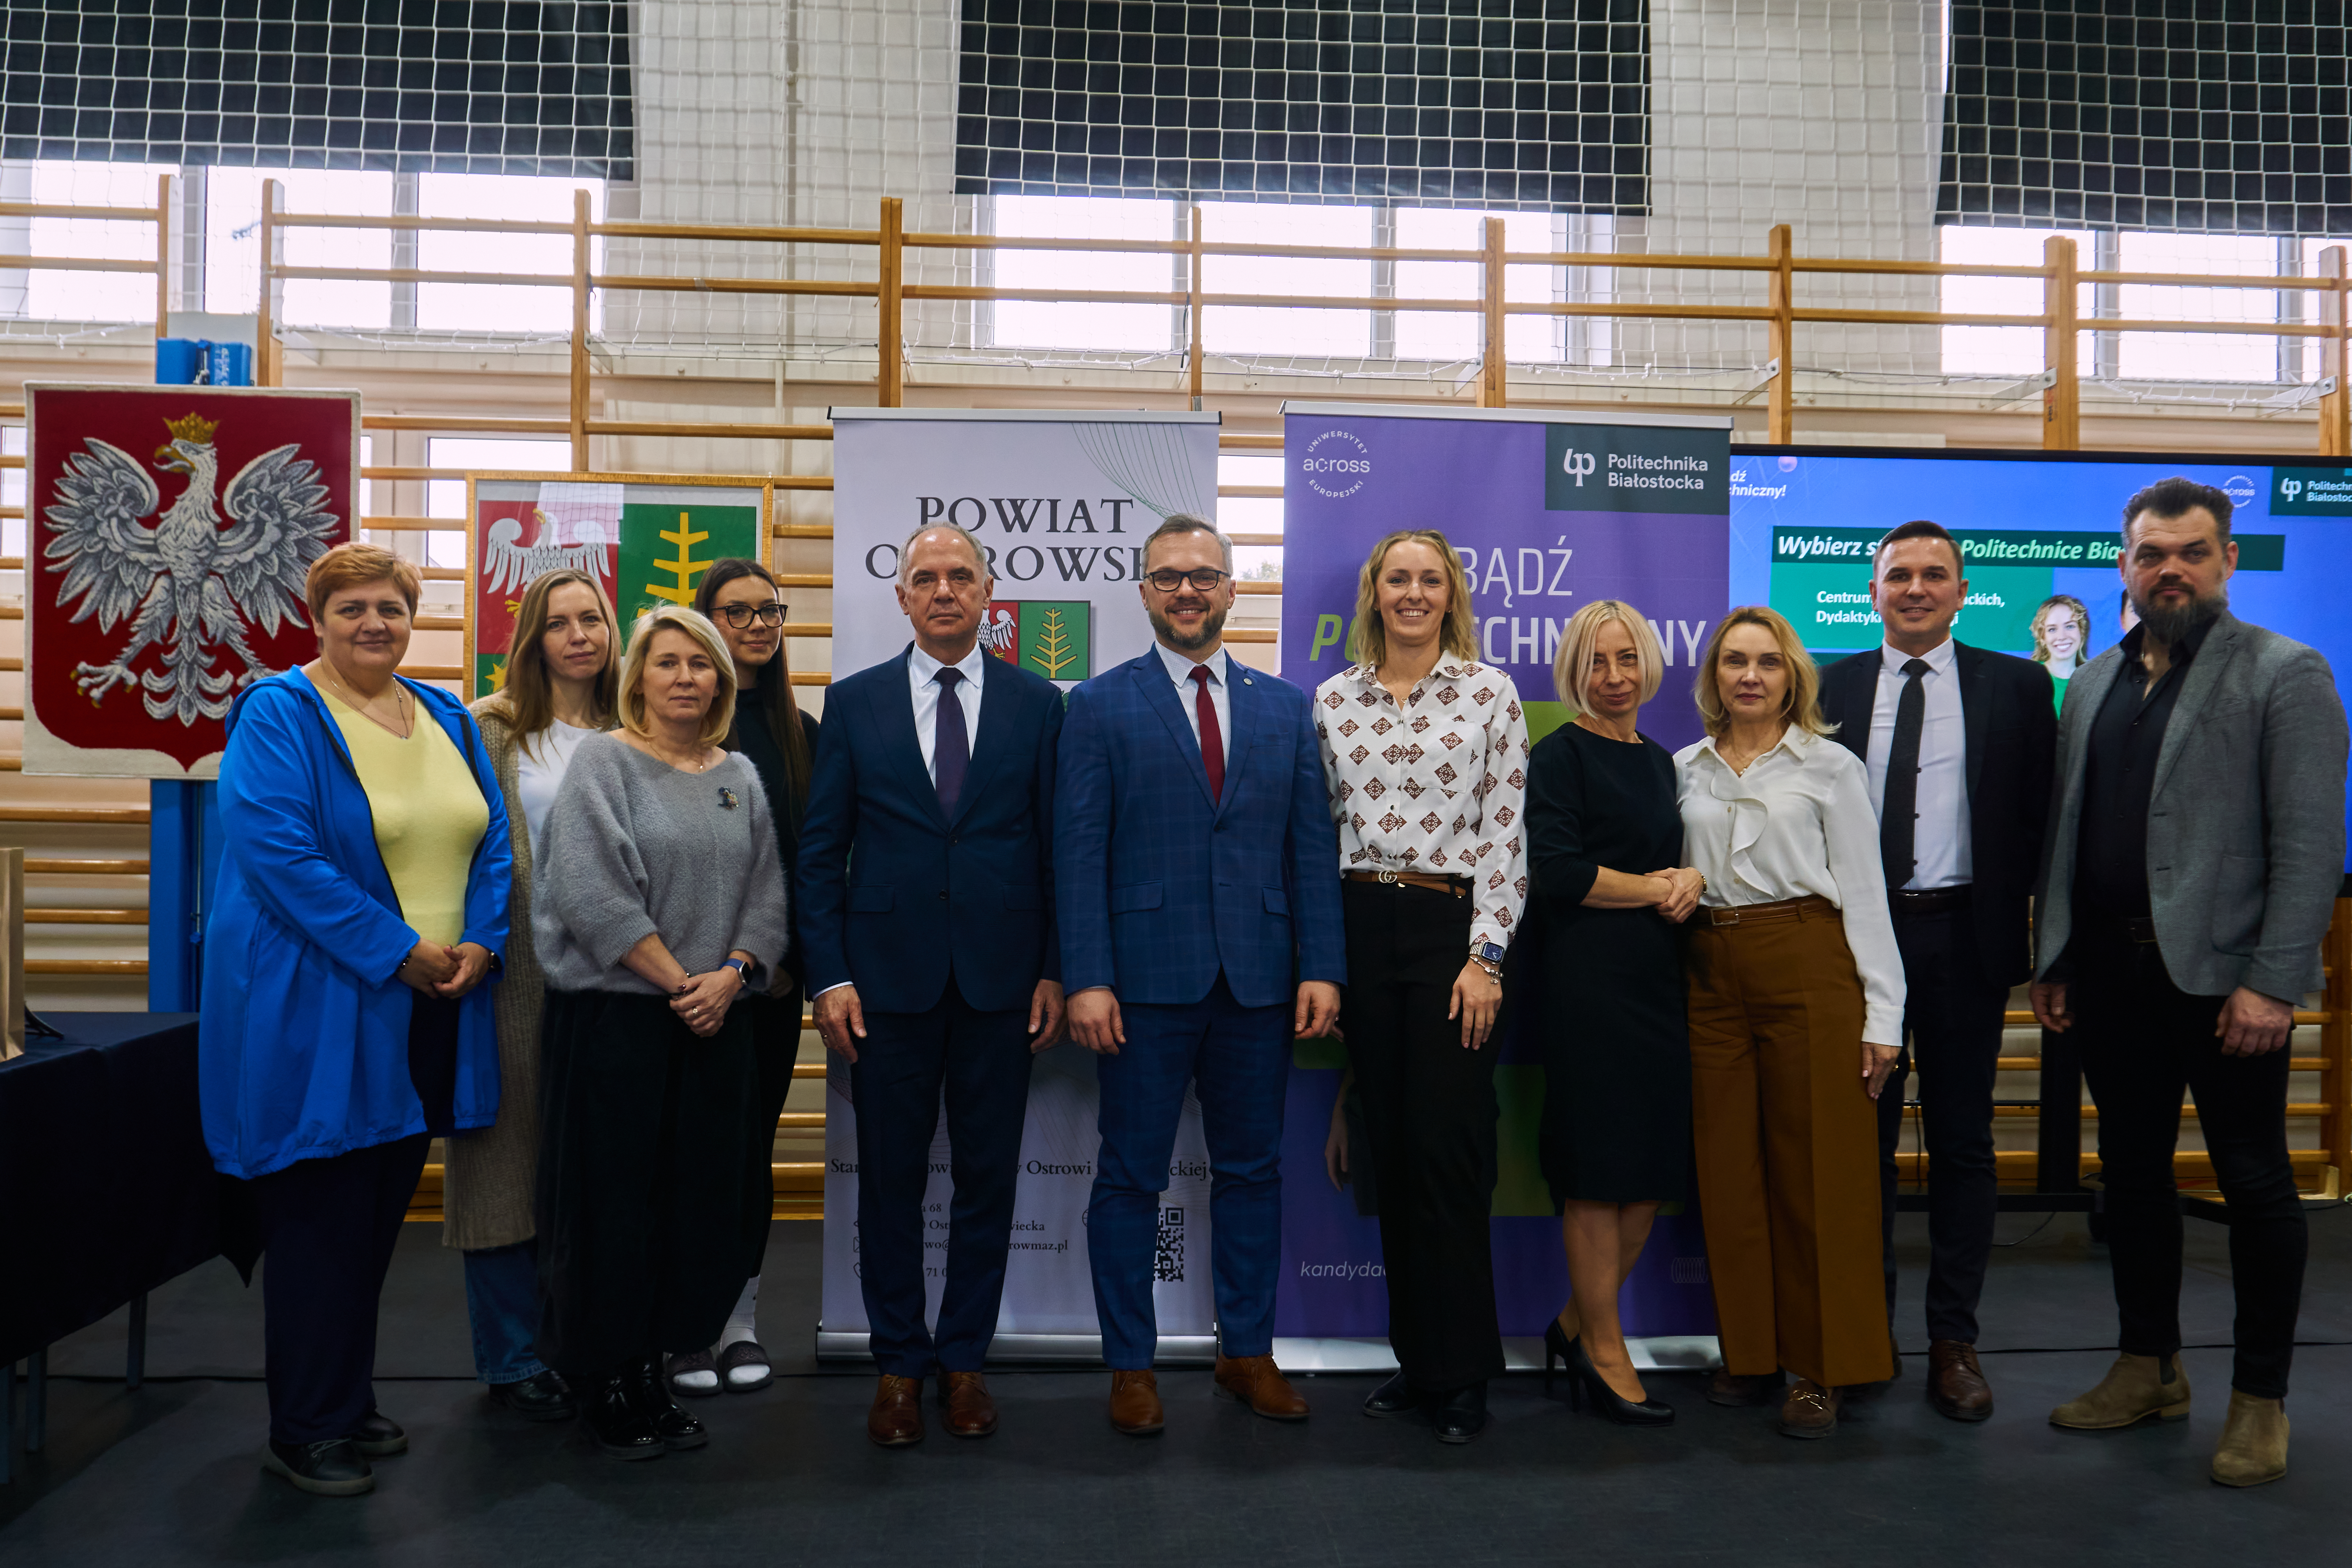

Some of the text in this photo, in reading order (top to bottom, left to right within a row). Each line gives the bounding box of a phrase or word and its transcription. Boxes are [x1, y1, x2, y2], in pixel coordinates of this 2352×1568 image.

[1307, 430, 1368, 454] UNIWERSYTET
[1303, 458, 1370, 473] across
[1608, 454, 1708, 471] Politechnika
[1308, 479, 1364, 498] EUROPEJSKI
[1608, 472, 1704, 490] Białostocka
[1729, 484, 1787, 499] hniczny!
[916, 497, 1134, 533] POWIAT
[1778, 535, 1863, 559] Wybierz
[1960, 539, 2083, 559] Politechnice
[1453, 535, 1573, 608] BĄDŹ
[1817, 590, 1873, 604] Centrum
[1027, 1160, 1092, 1175] Ostrowi
[929, 1203, 942, 1212] 68
[929, 1220, 950, 1230] Ost
[1300, 1261, 1386, 1281] kandyda
